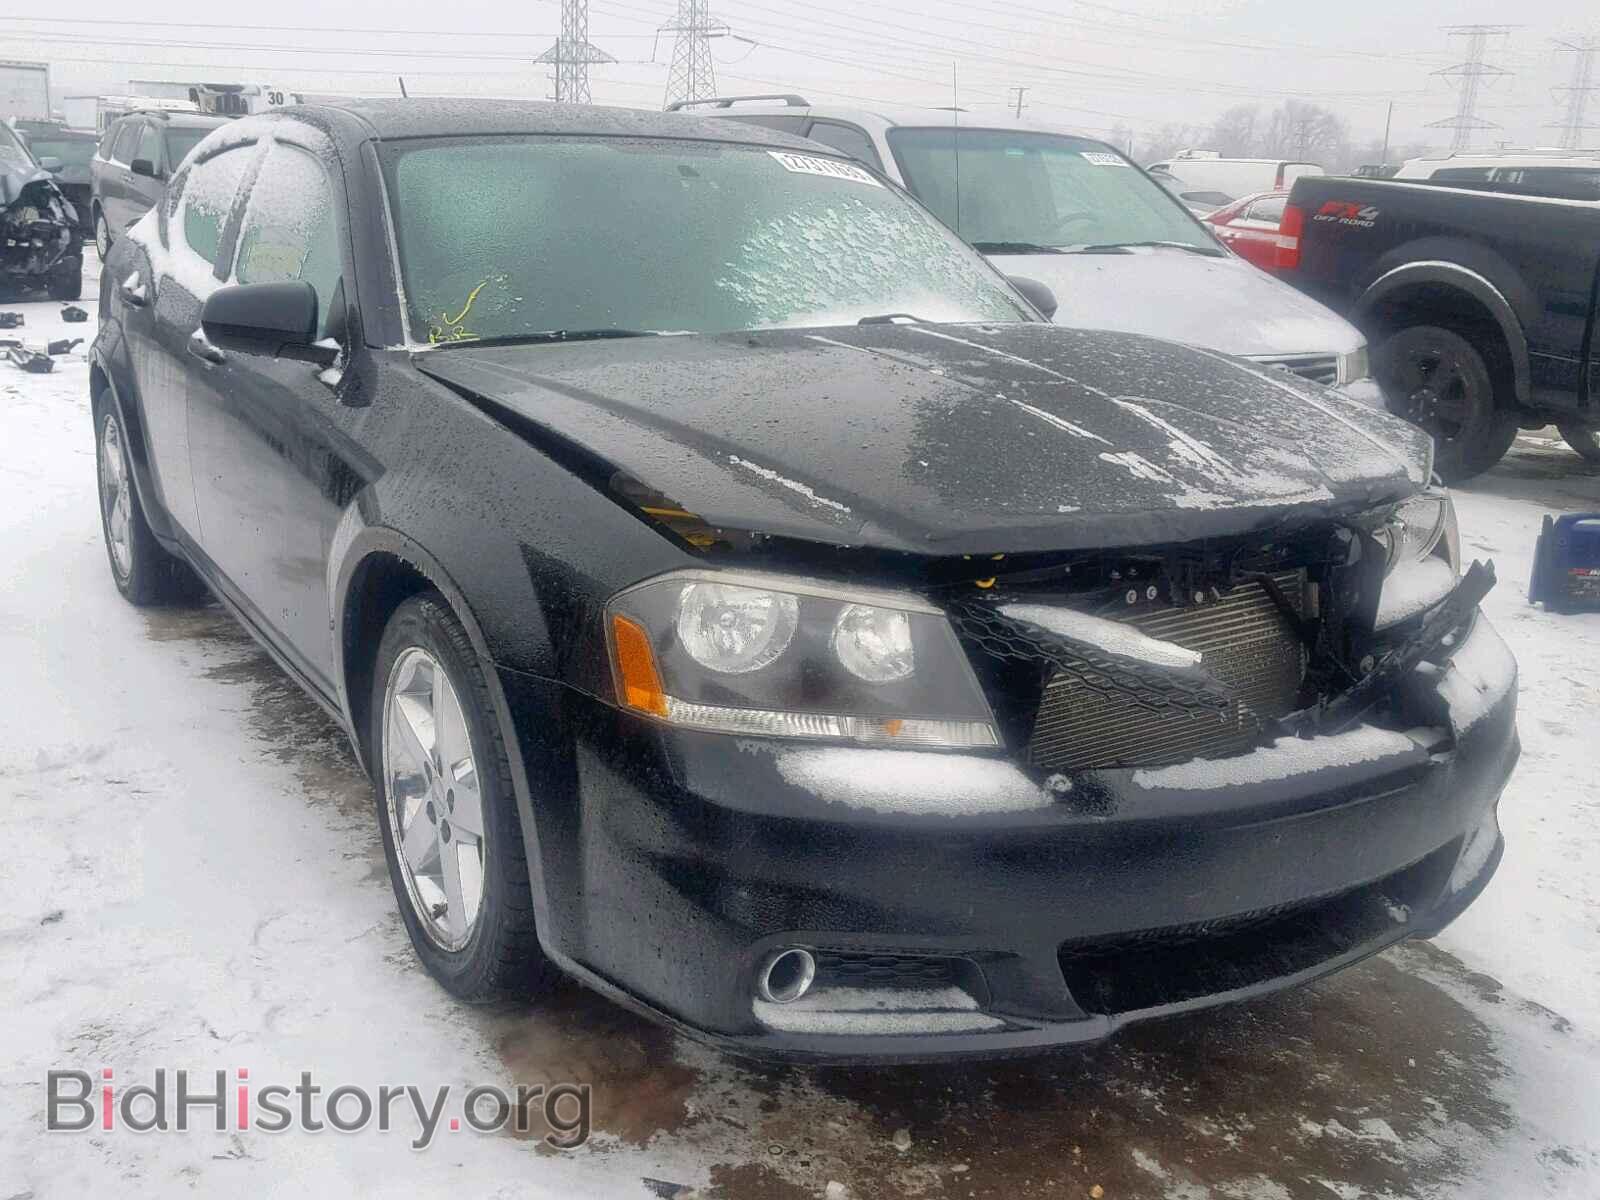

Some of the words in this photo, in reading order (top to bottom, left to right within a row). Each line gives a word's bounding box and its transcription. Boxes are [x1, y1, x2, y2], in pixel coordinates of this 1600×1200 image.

[267, 91, 284, 105] 30
[1317, 201, 1379, 220] FX4
[1312, 214, 1338, 223] OFF
[1339, 217, 1376, 228] ROAD
